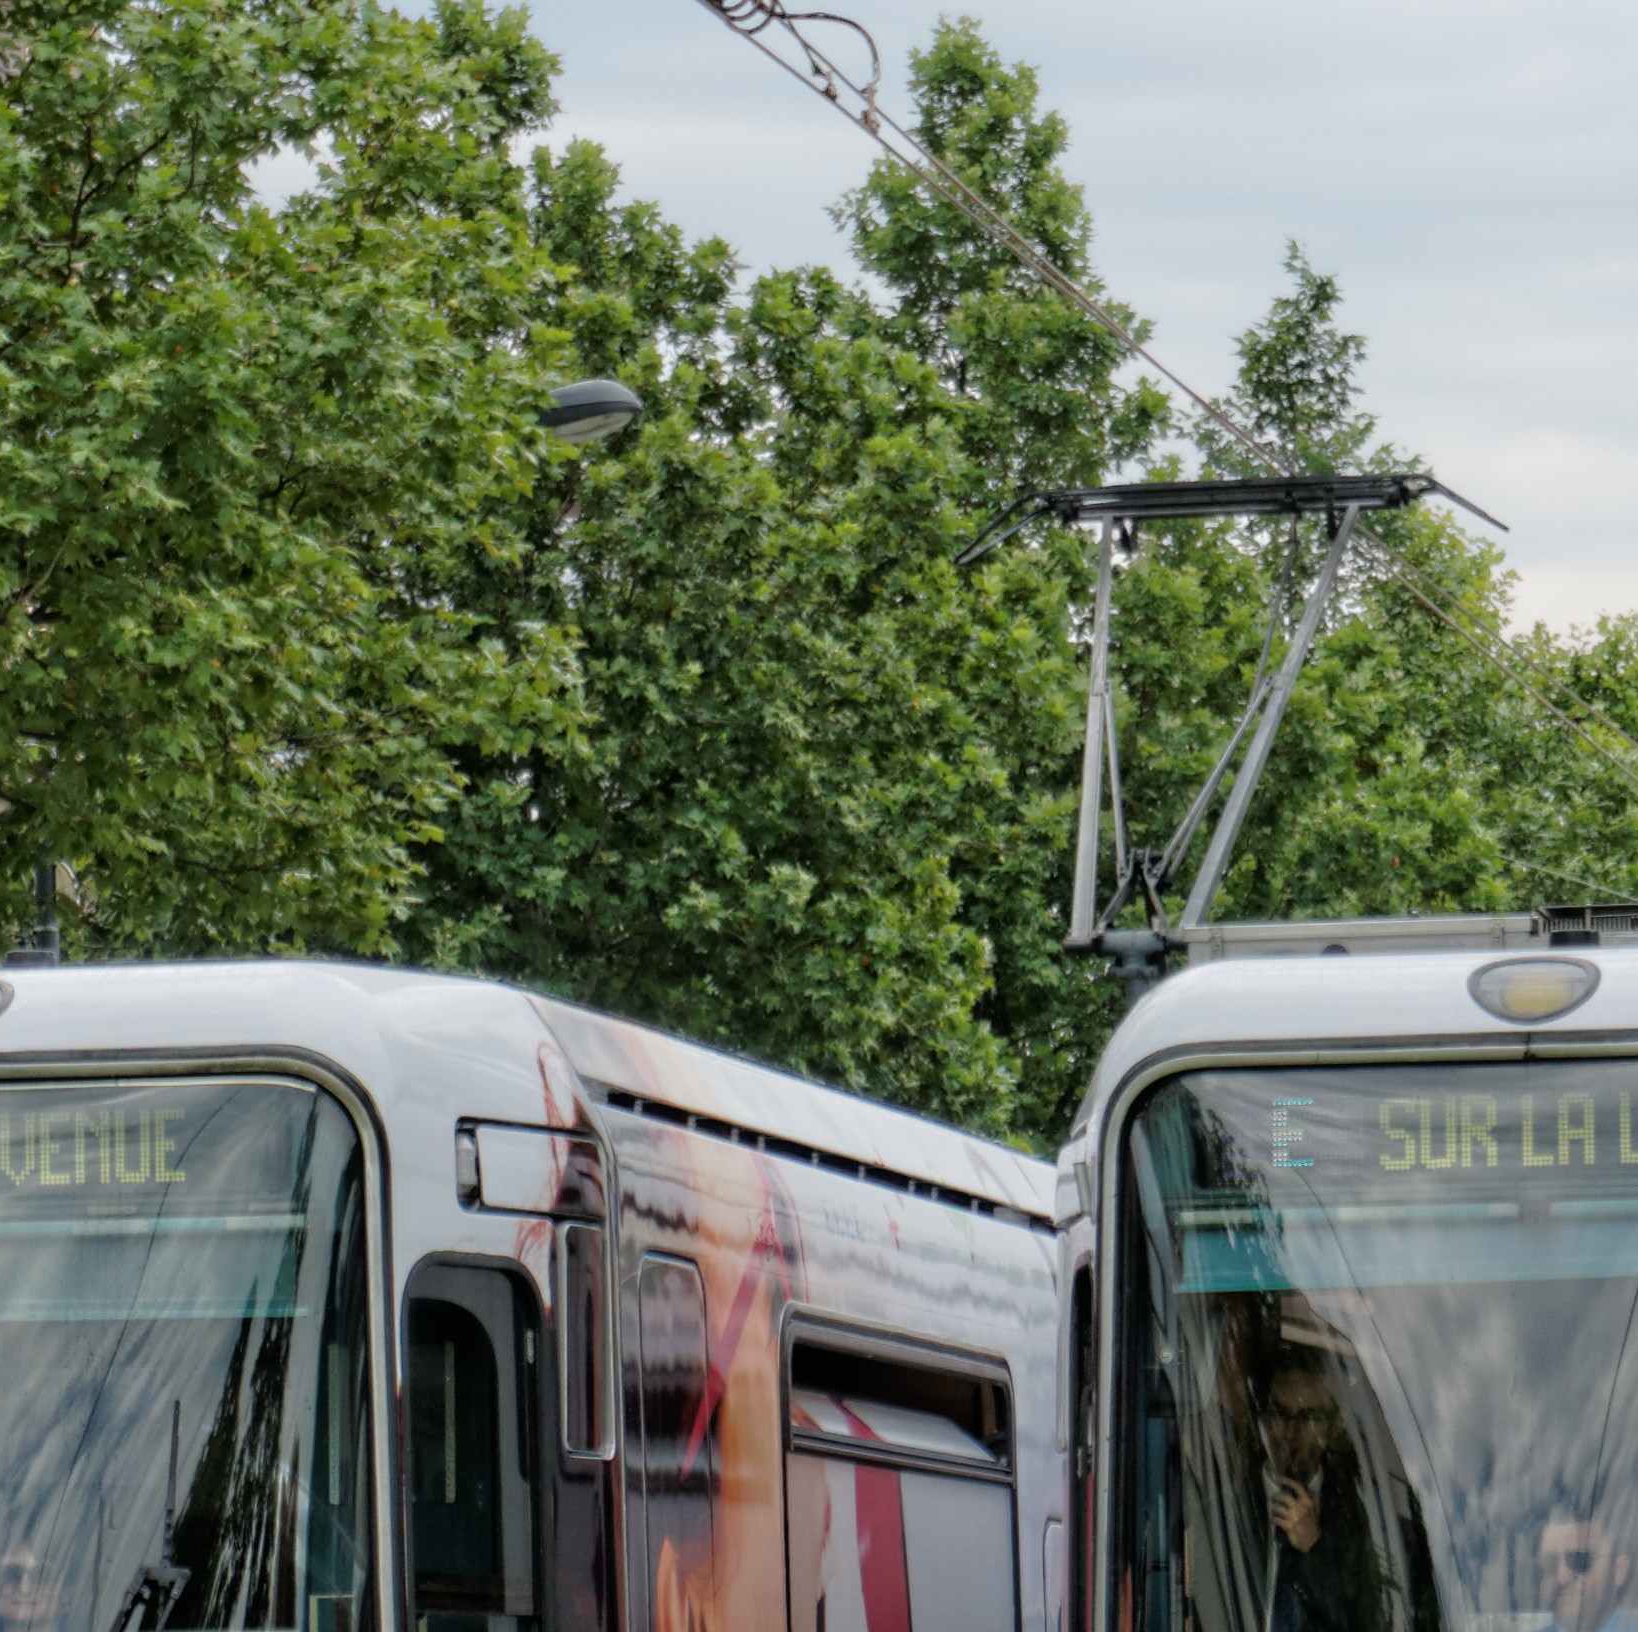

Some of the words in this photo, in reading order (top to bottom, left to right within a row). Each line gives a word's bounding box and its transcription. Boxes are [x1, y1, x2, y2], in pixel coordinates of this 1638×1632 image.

[1272, 1097, 1313, 1168] E
[1379, 1095, 1499, 1171] SUR
[1521, 1092, 1597, 1167] LA
